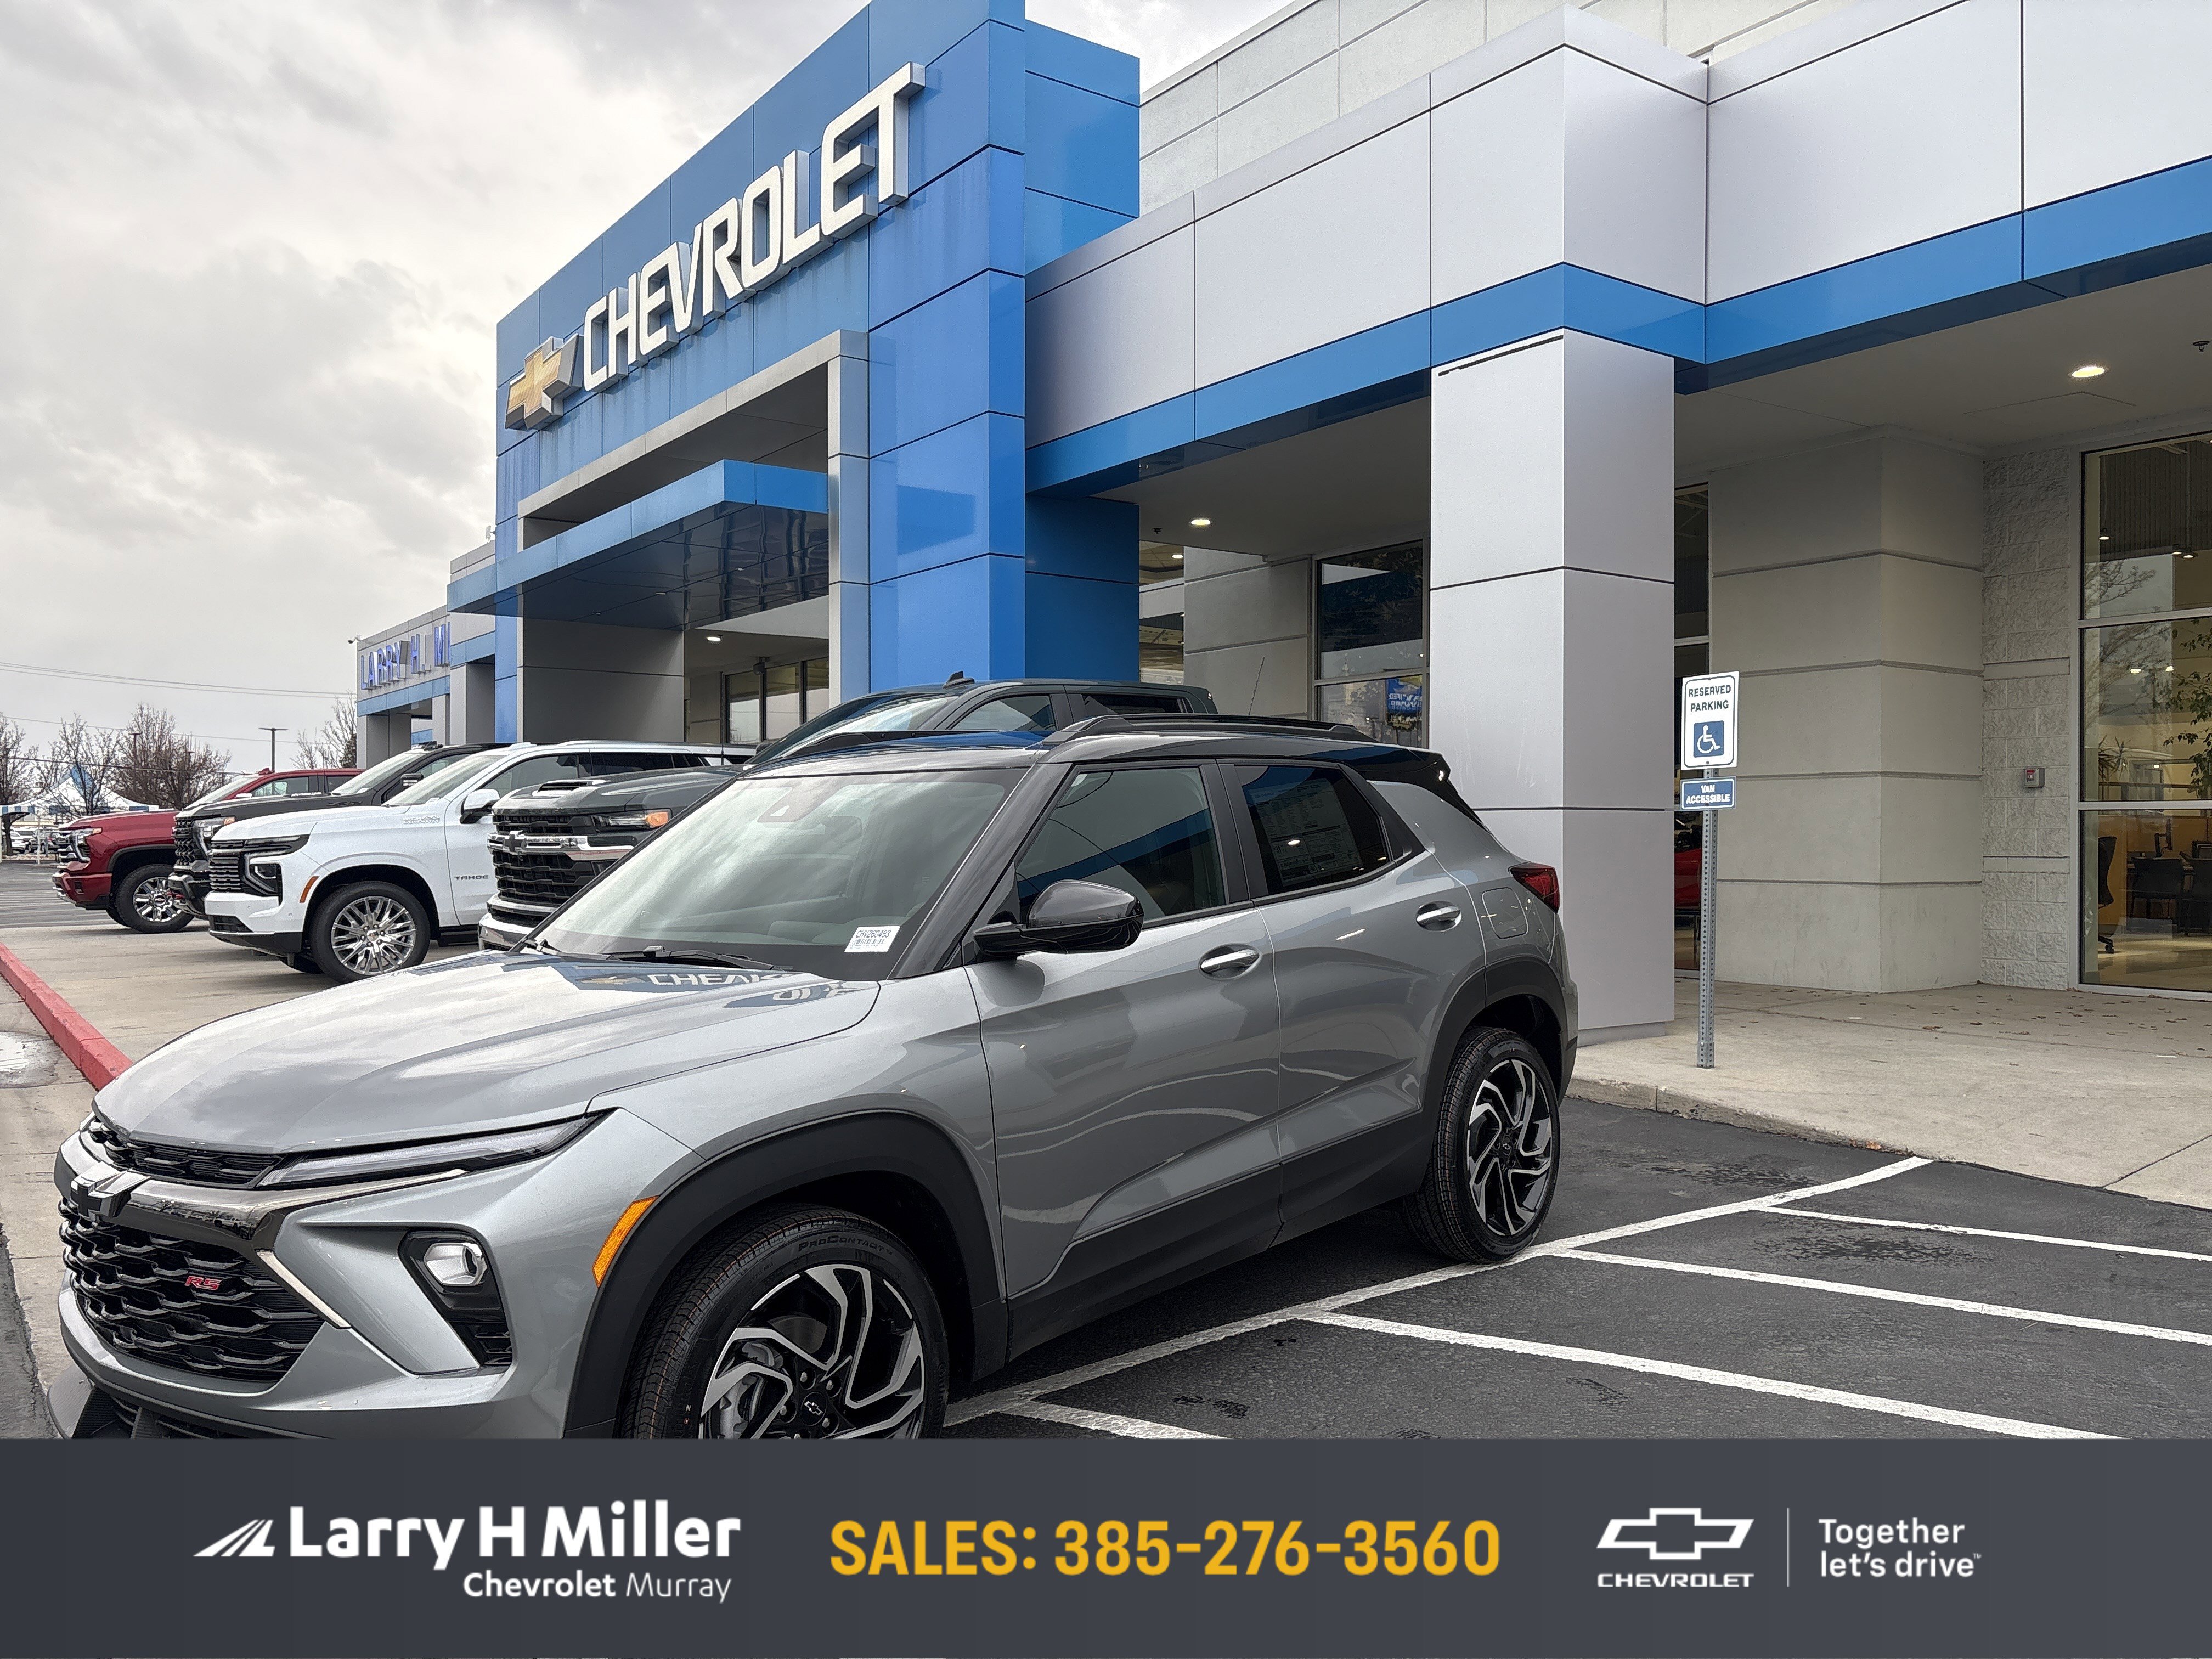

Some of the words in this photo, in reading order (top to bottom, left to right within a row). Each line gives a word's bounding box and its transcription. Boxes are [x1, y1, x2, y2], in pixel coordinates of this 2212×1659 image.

[584, 61, 926, 393] CHEVROLET
[360, 641, 406, 690] LARRY
[411, 634, 428, 674] H.
[1688, 684, 1731, 698] RESERVED
[1690, 699, 1729, 712] PARKING
[1701, 785, 1715, 793] VAN
[1685, 793, 1731, 805] ACCESSIBLE
[184, 1276, 223, 1291] RS
